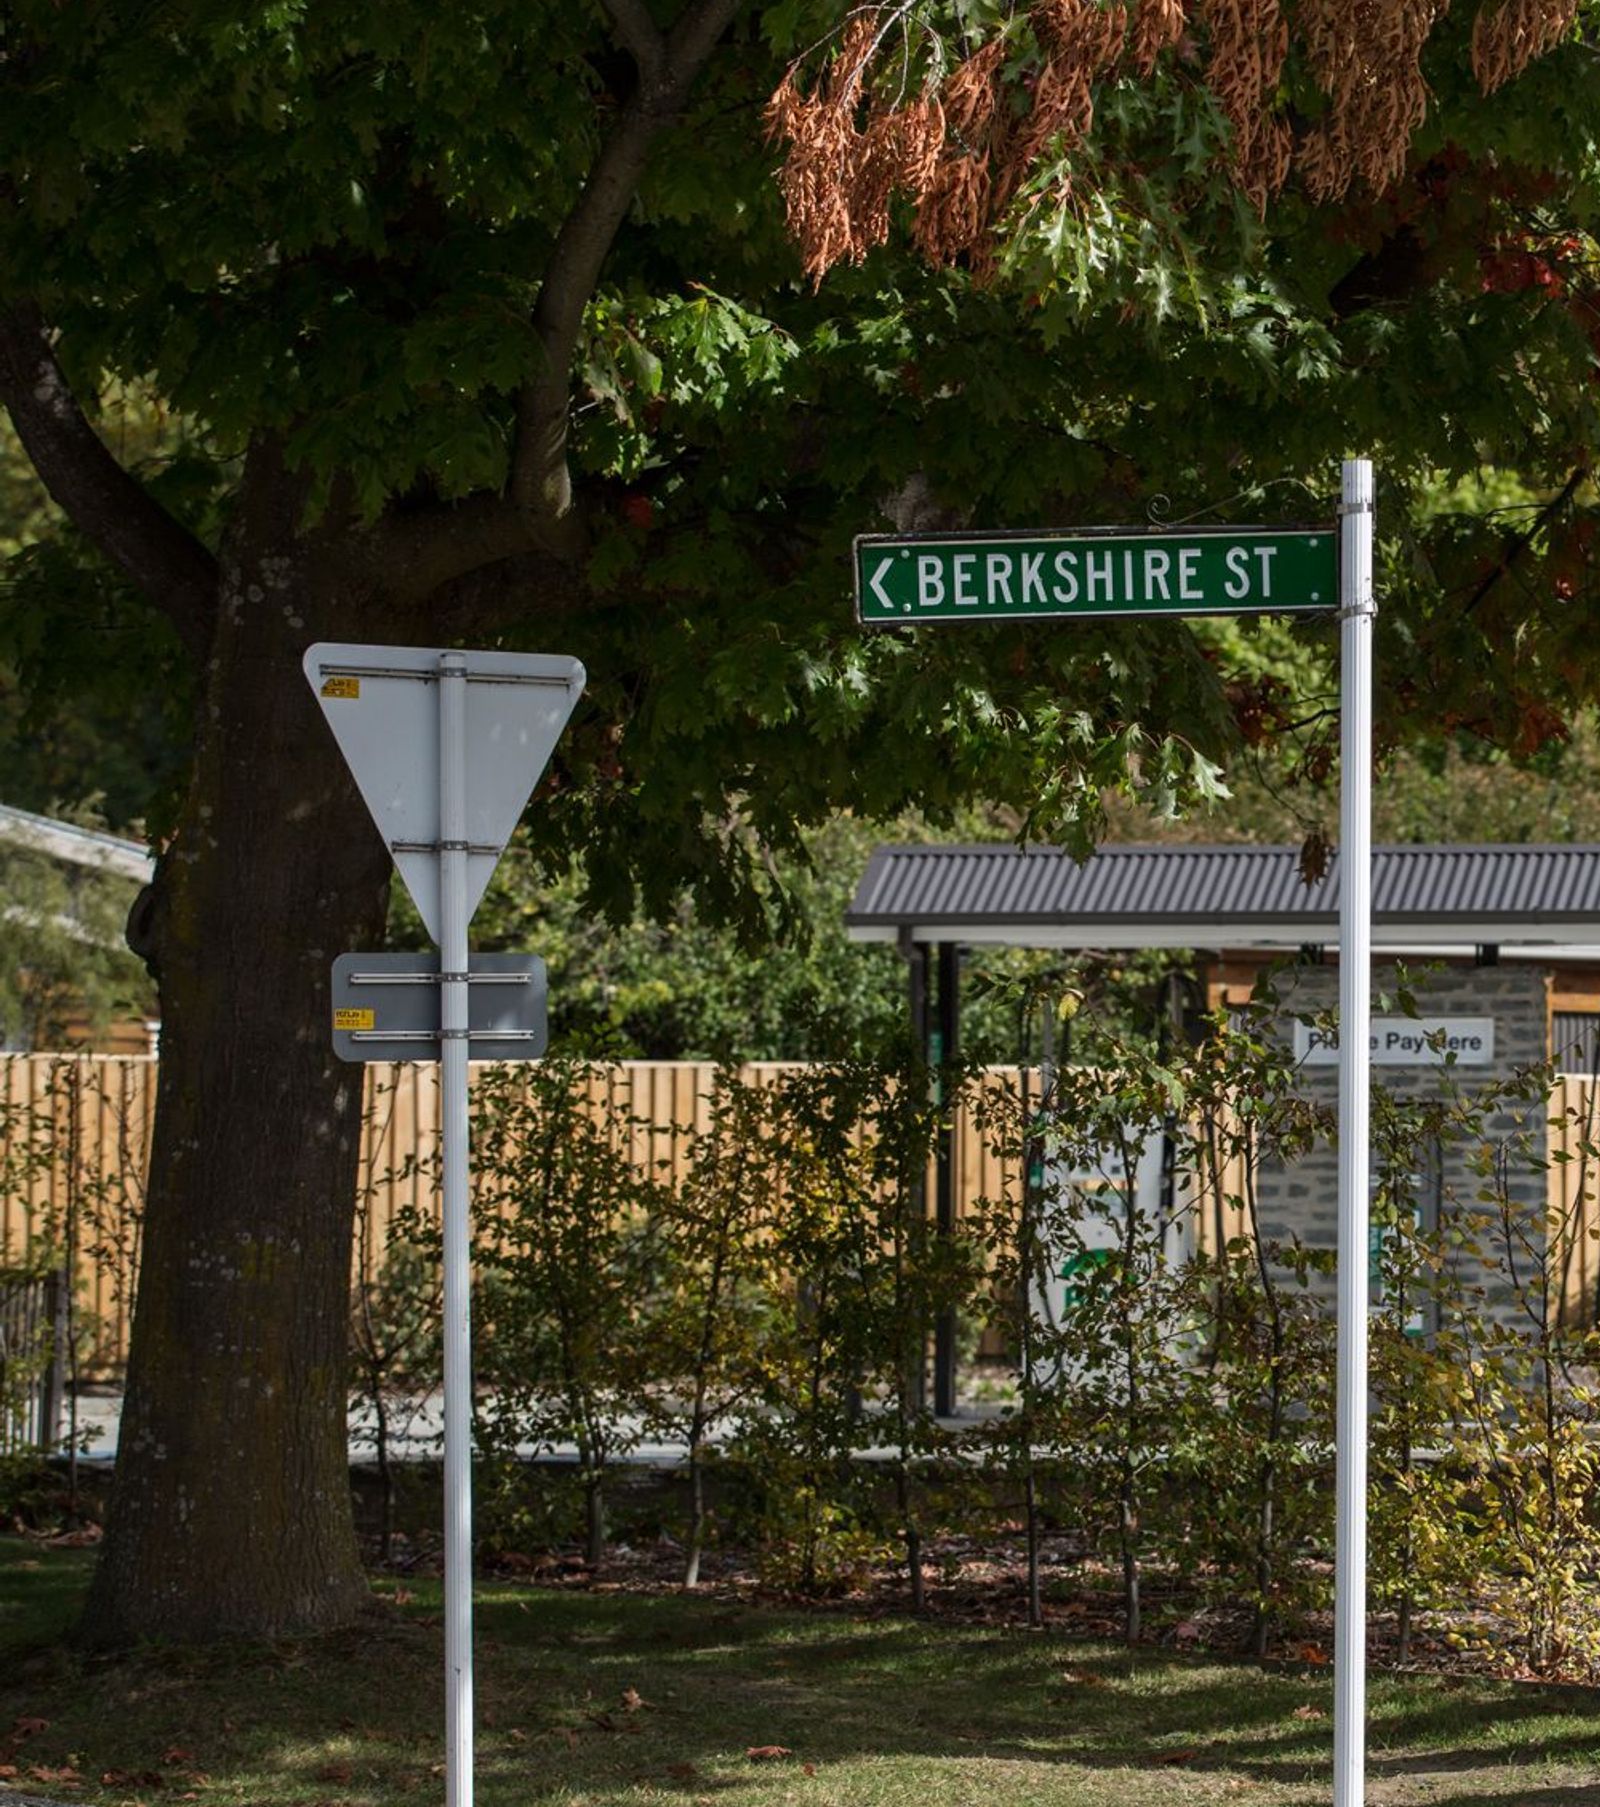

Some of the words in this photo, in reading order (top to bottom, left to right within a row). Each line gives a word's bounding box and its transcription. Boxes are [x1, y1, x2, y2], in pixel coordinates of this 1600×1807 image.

[918, 549, 1204, 606] BERKSHIRE
[1224, 547, 1278, 598] ST
[1385, 1032, 1425, 1054] Pay
[1431, 1032, 1482, 1051] ere
